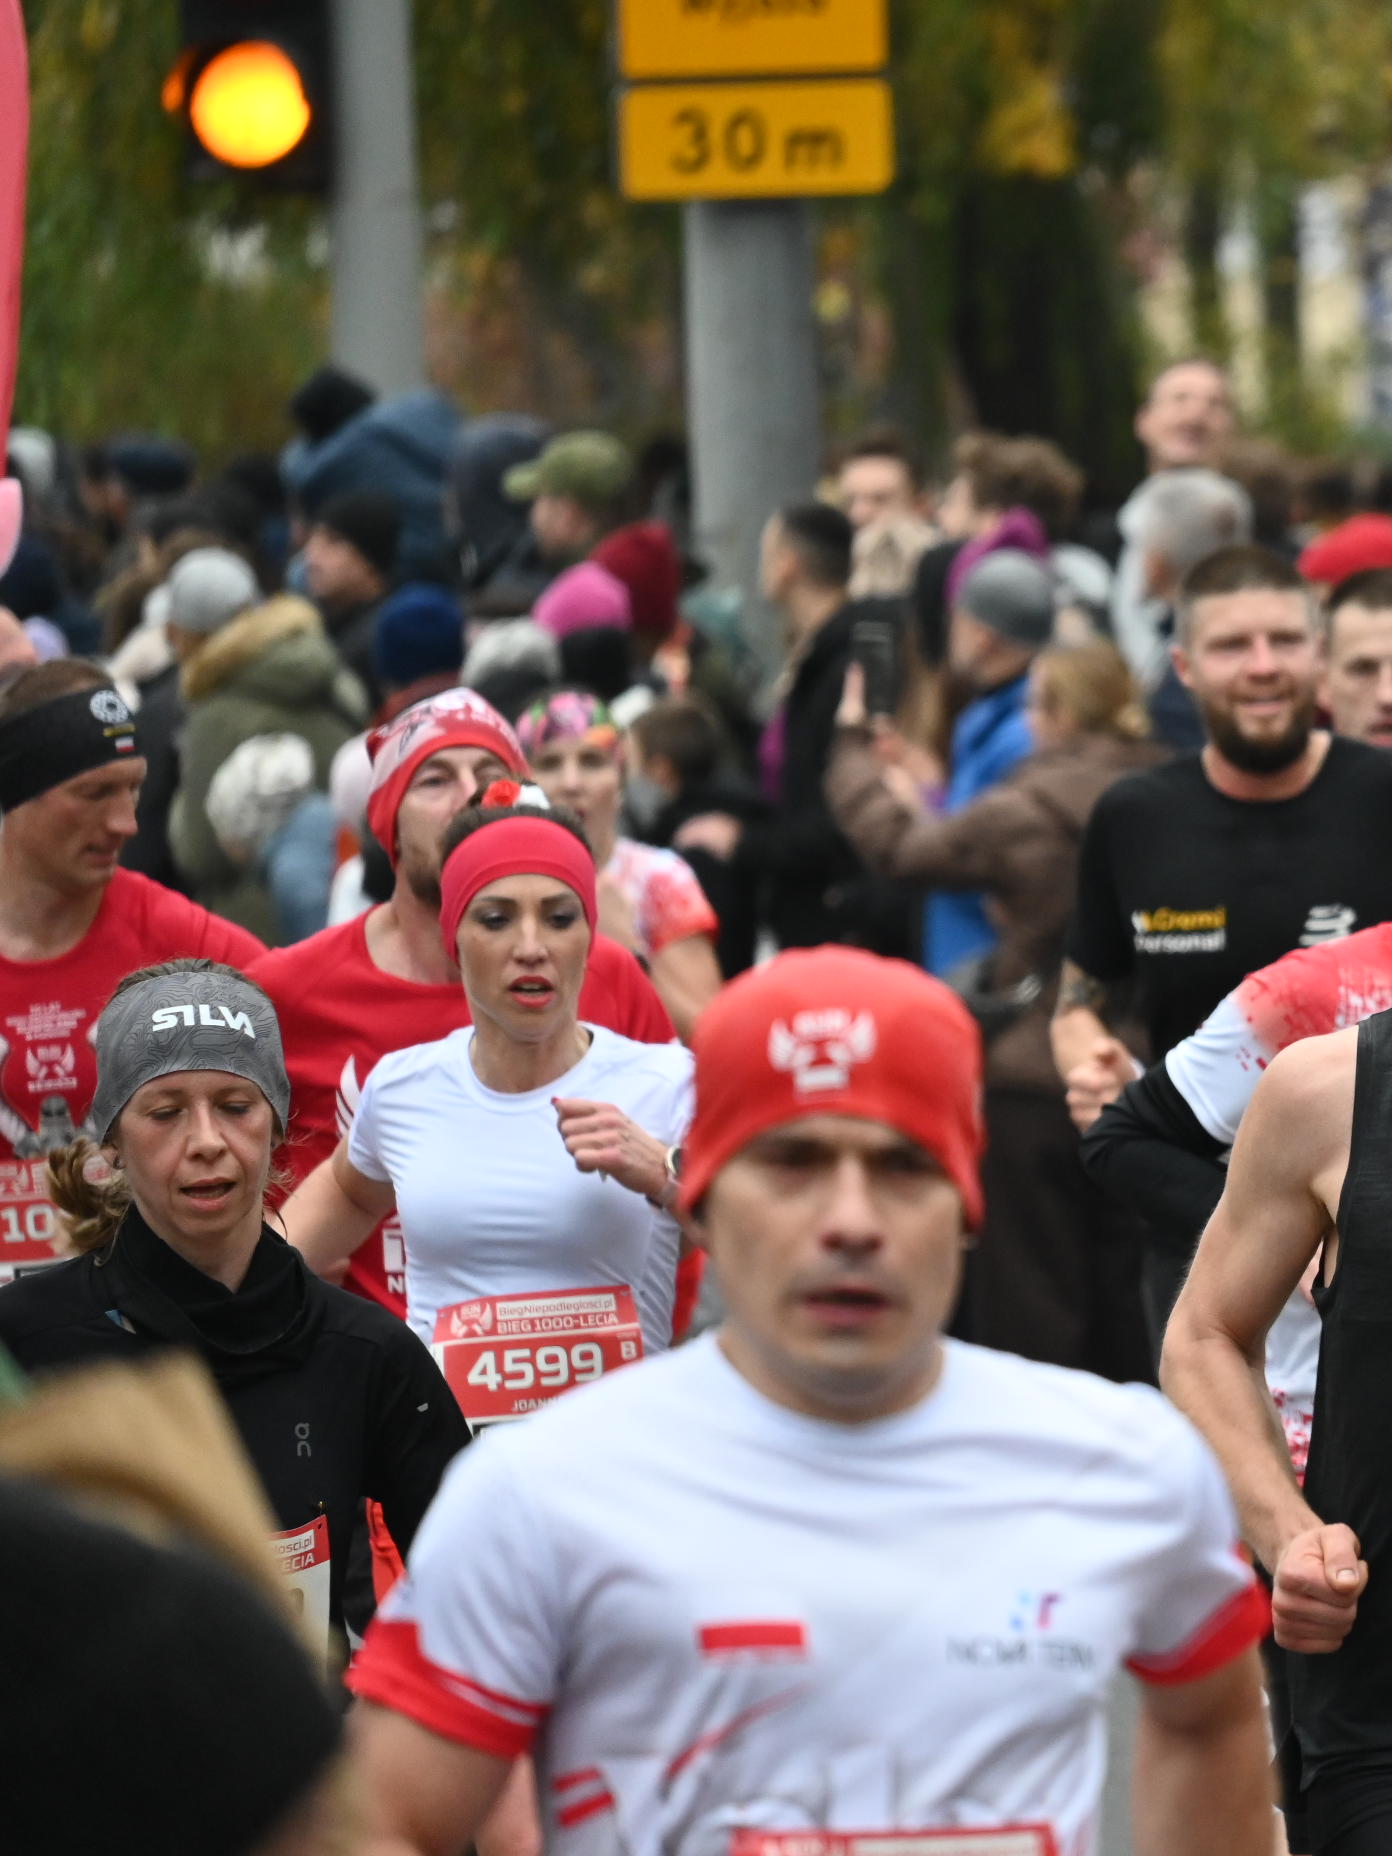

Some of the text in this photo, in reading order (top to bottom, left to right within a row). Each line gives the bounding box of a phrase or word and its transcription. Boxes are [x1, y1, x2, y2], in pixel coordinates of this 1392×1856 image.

[670, 108, 845, 175] 30 m
[152, 1004, 256, 1039] SILVA
[0, 1203, 55, 1242] 10
[497, 1312, 619, 1334] BIEG 1000-LECIA
[467, 1340, 637, 1392] 4599 B
